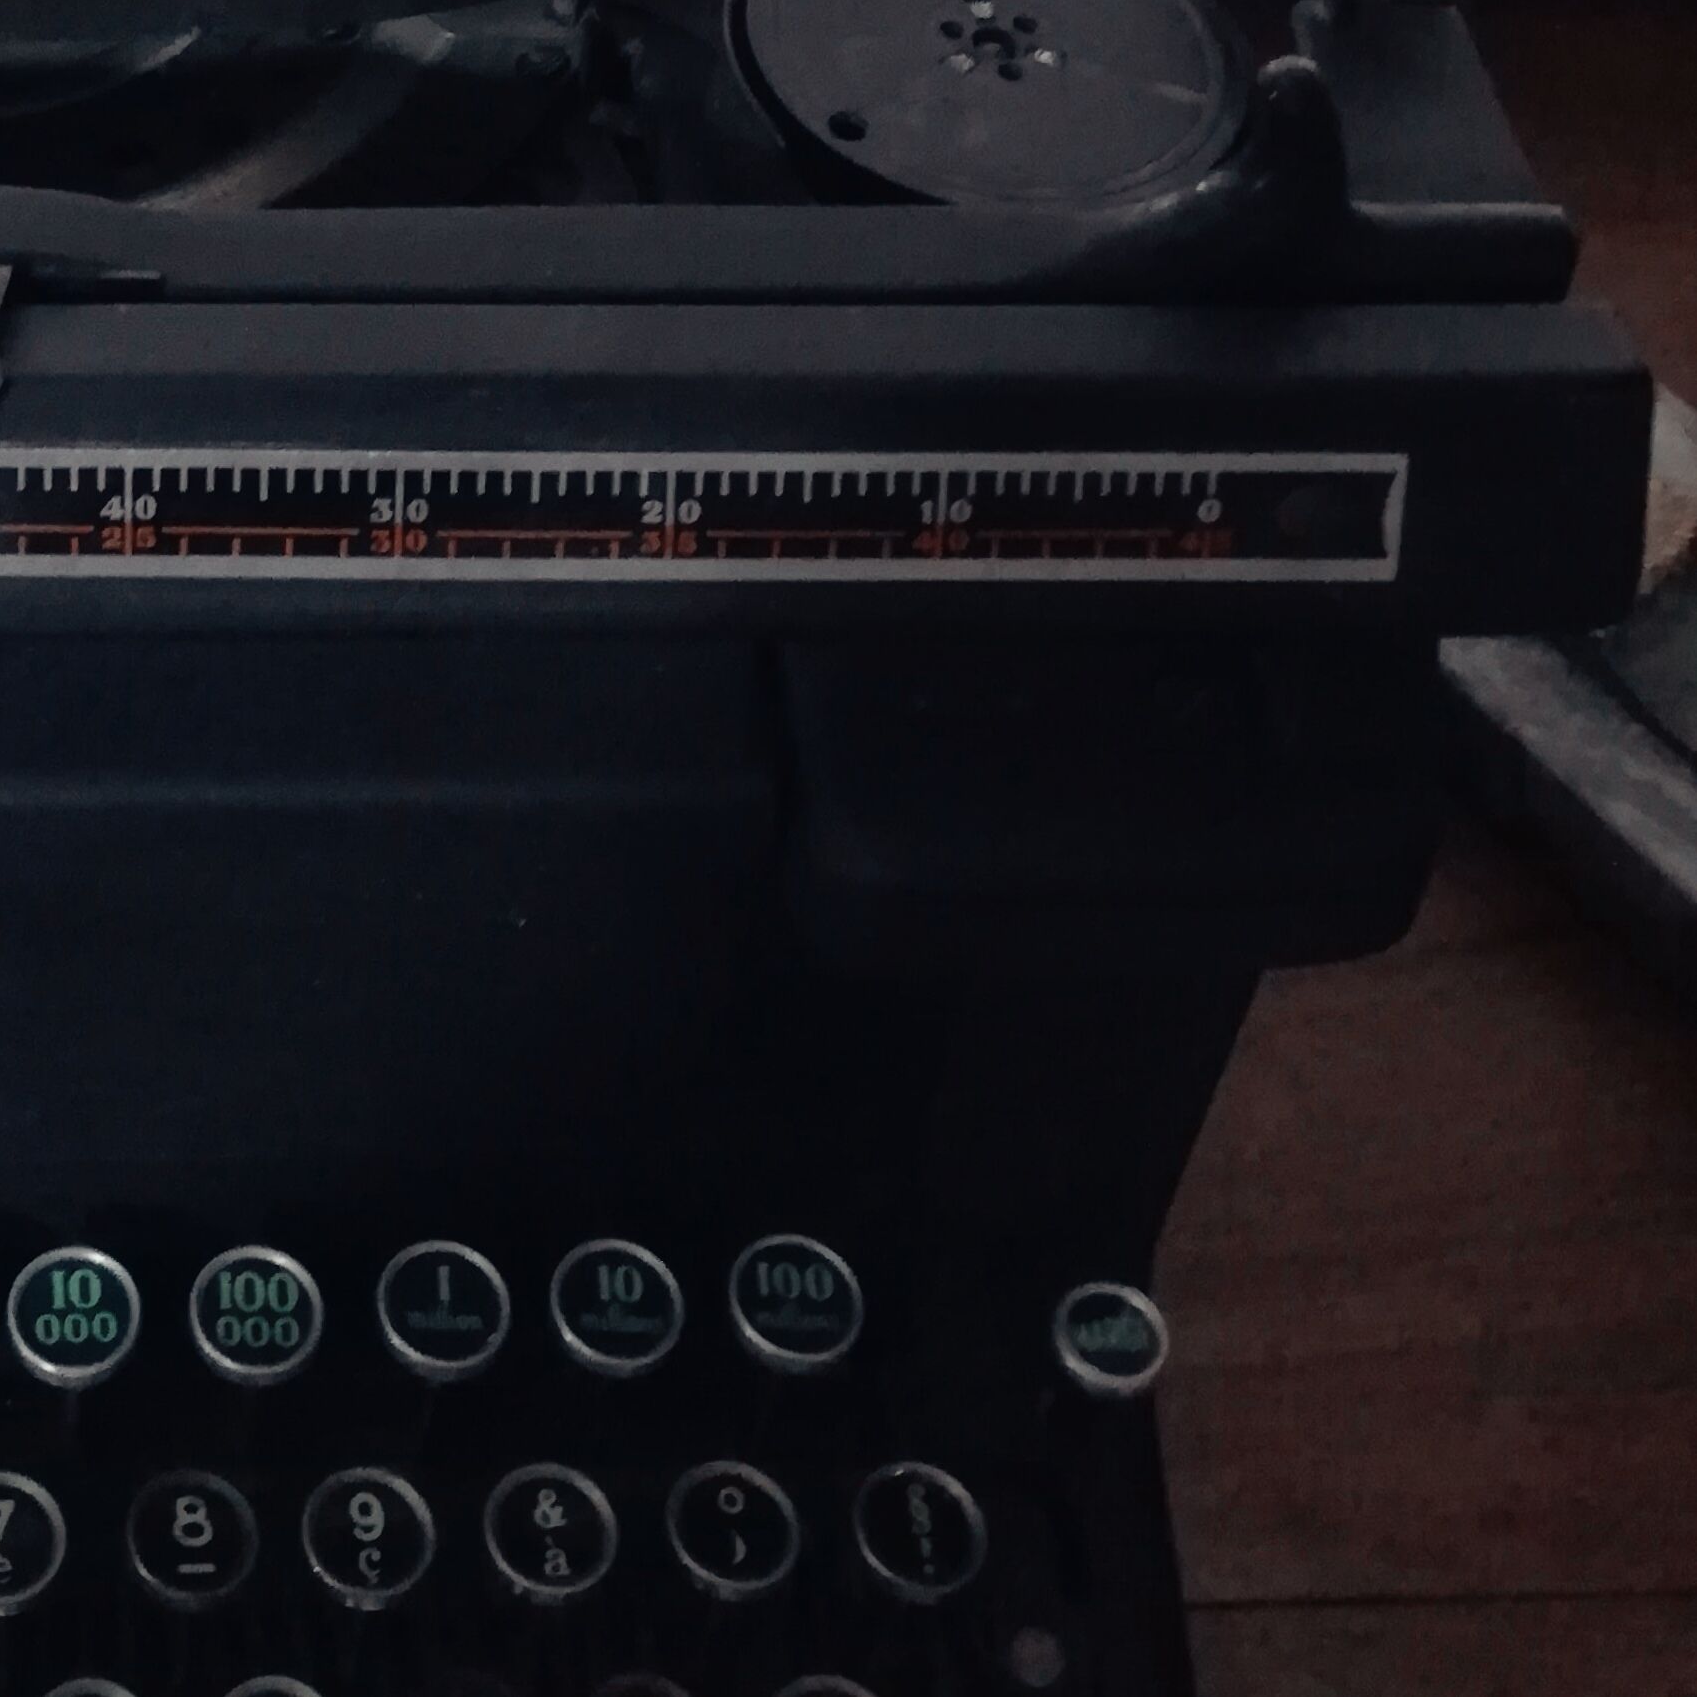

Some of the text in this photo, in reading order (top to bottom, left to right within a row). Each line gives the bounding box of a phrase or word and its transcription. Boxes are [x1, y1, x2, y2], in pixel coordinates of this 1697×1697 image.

[100, 495, 157, 522] 40
[370, 497, 429, 524] 30
[641, 499, 702, 525] 20
[920, 499, 972, 525] 10
[102, 525, 156, 550] 25
[50, 1268, 101, 1308] 10
[219, 1270, 298, 1313] 100
[597, 1264, 644, 1304] 10
[757, 1261, 835, 1303] 100
[35, 1311, 118, 1345] 000
[216, 1315, 299, 1348] 000
[172, 1495, 214, 1547] 8
[348, 1491, 385, 1543] 9
[533, 1487, 568, 1529] &
